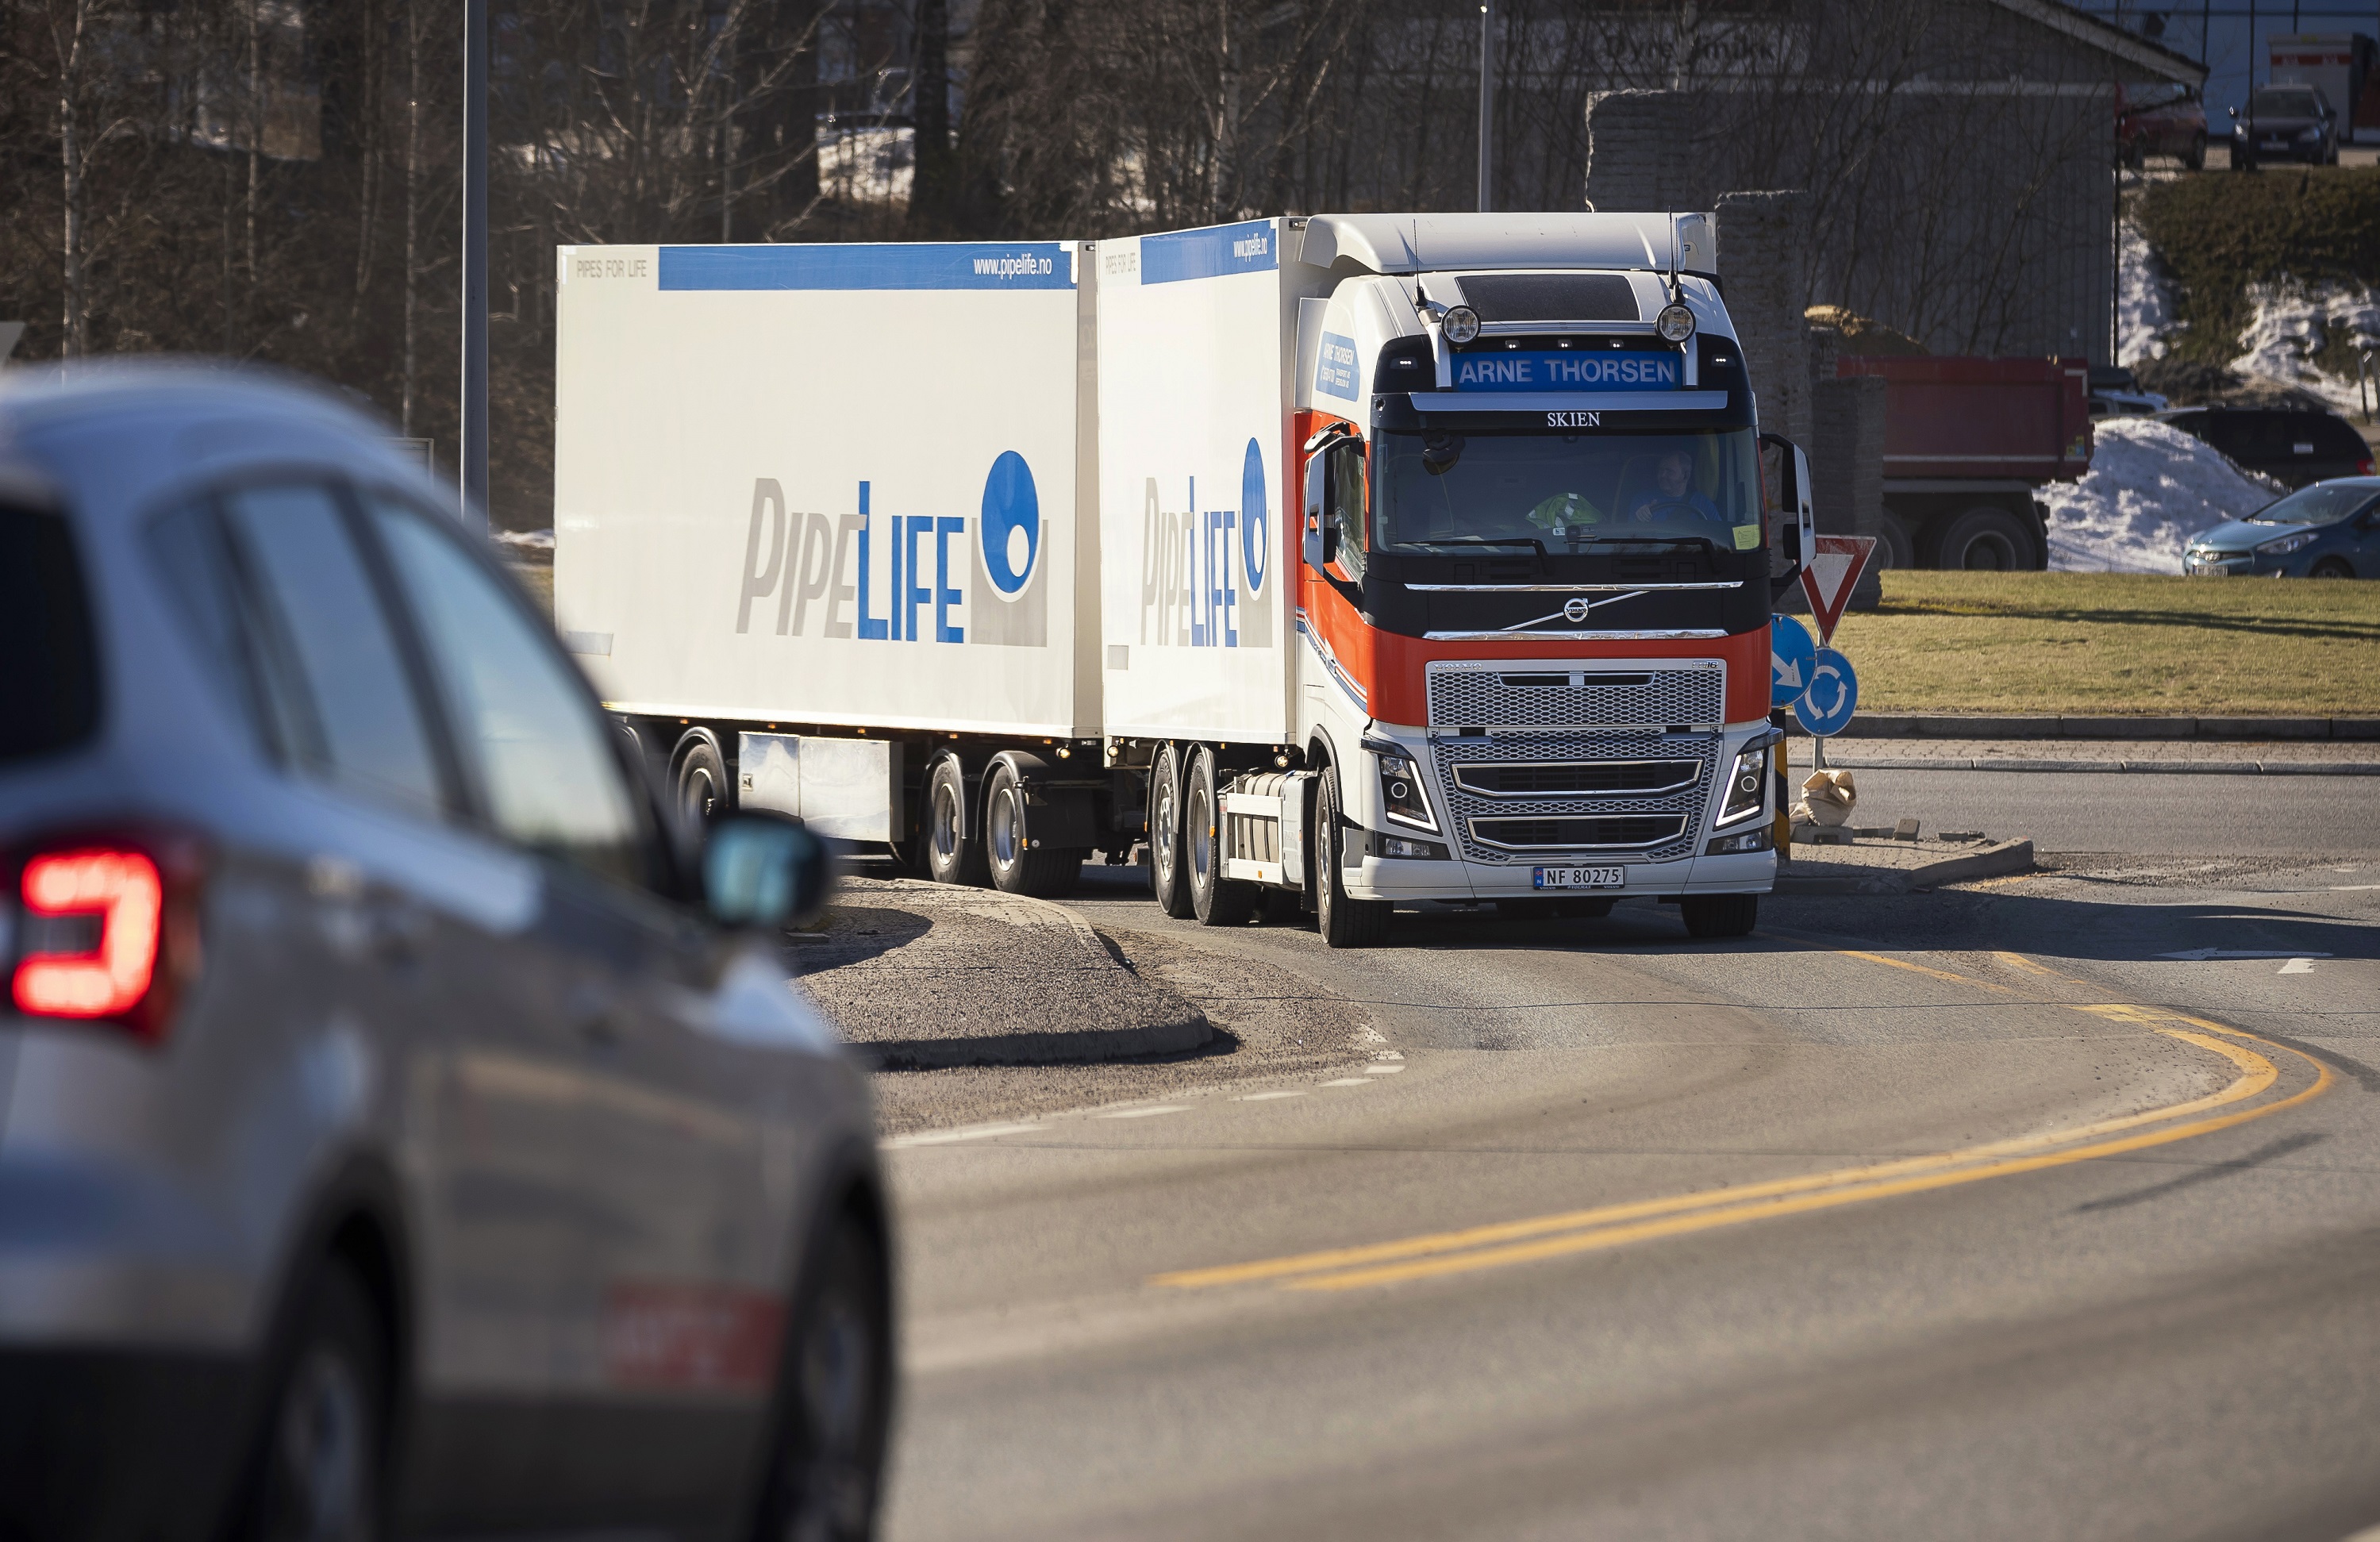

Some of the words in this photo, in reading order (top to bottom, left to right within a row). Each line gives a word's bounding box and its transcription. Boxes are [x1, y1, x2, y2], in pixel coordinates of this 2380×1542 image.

[1233, 232, 1268, 263] www.pipelife.no
[577, 260, 602, 278] PIPES
[606, 260, 625, 277] FOR
[629, 260, 647, 277] LIFE
[973, 252, 1052, 279] www.pipelife.no
[1459, 360, 1533, 383] ARNE
[1544, 359, 1675, 383] THORSEN
[1548, 412, 1600, 427] SKIEN
[1433, 662, 1483, 671] VOLVO
[1547, 870, 1566, 884] NF
[1573, 869, 1619, 884] 80275
